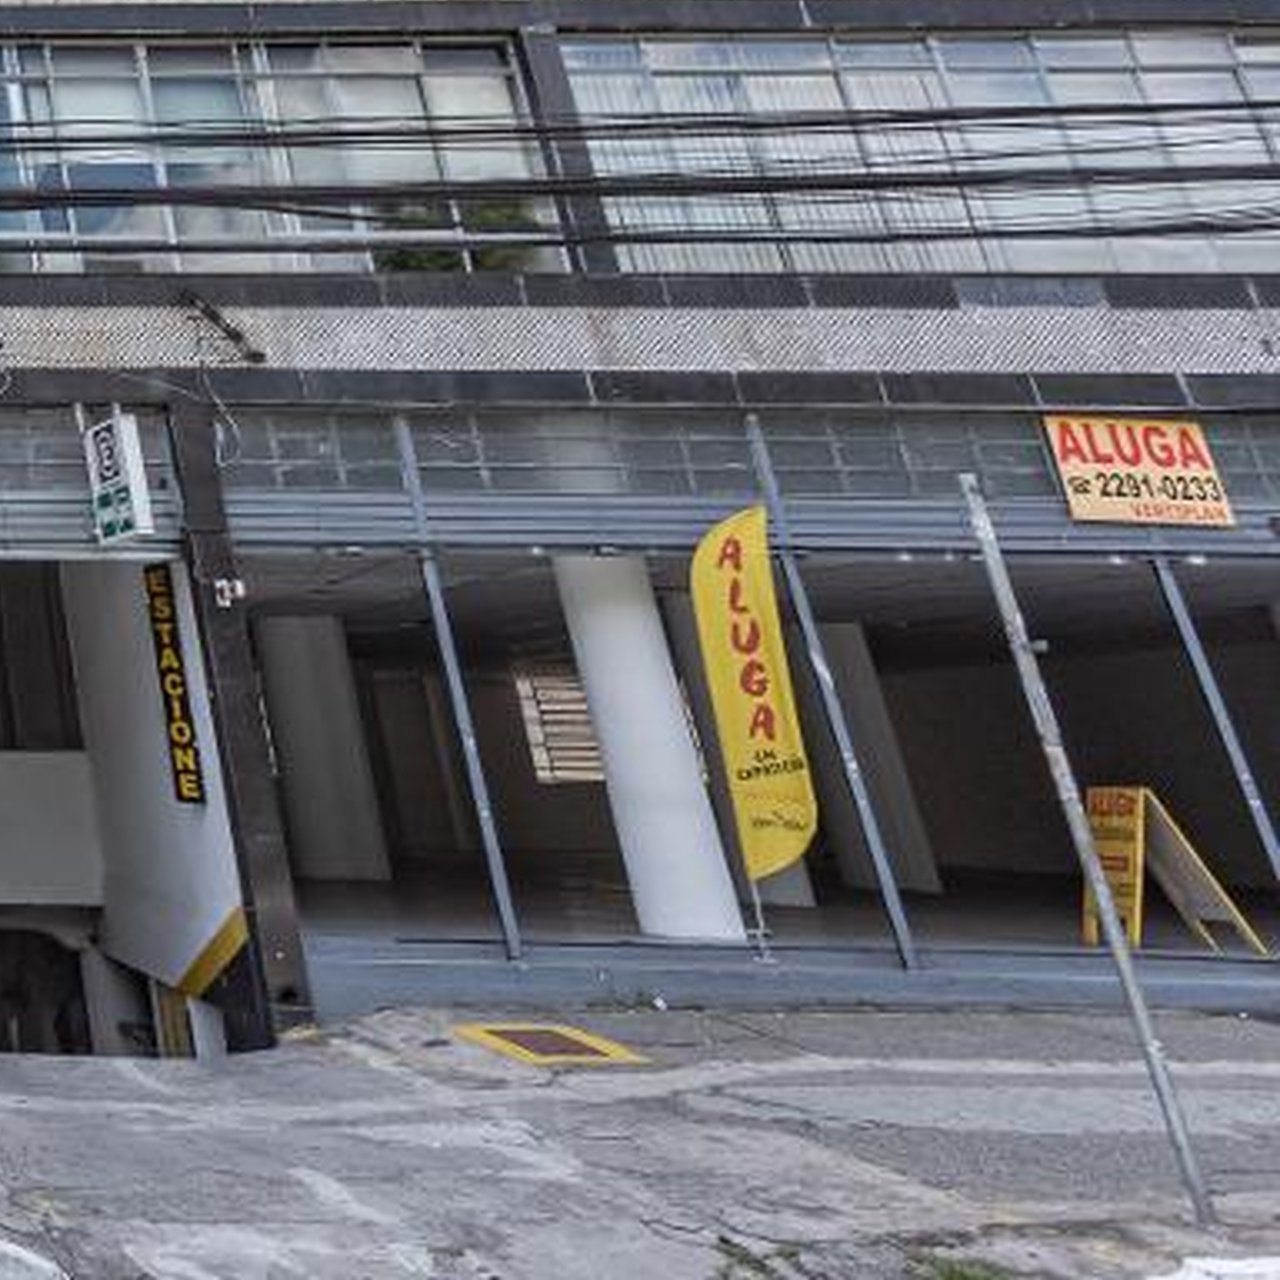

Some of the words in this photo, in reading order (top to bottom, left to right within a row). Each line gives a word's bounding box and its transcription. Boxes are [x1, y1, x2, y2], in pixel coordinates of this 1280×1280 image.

[1058, 421, 1210, 470] ALUGA
[149, 568, 200, 799] ESTACIONE
[718, 535, 776, 742] ALUGA
